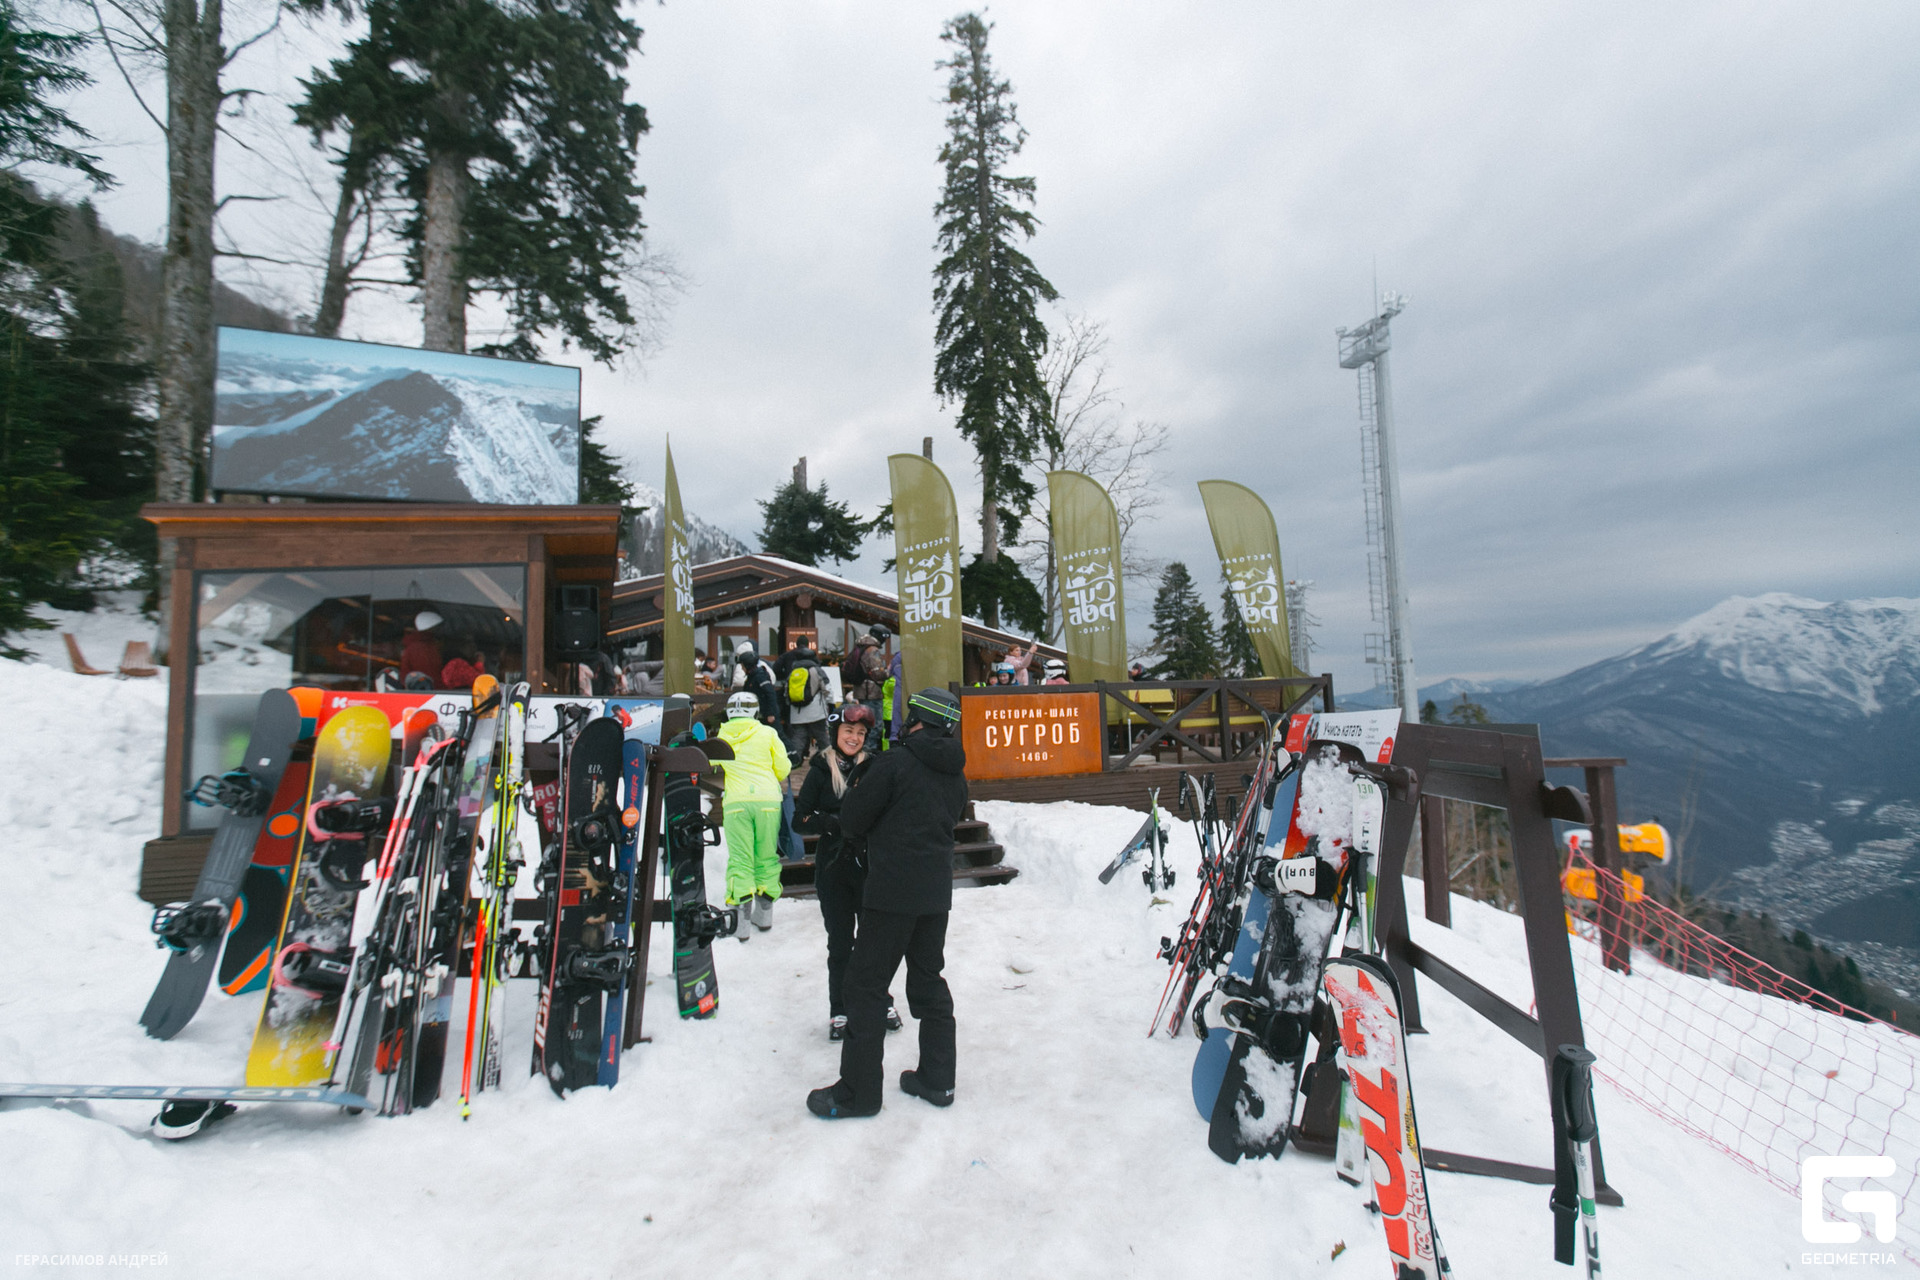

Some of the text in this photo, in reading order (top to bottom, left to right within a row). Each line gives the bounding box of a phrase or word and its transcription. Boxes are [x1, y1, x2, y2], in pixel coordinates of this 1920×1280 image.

[985, 707, 1079, 720] РЕСТОРАН-ШАЛЕ
[985, 722, 1080, 748] СУГРОБ
[1322, 722, 1341, 736] Учись
